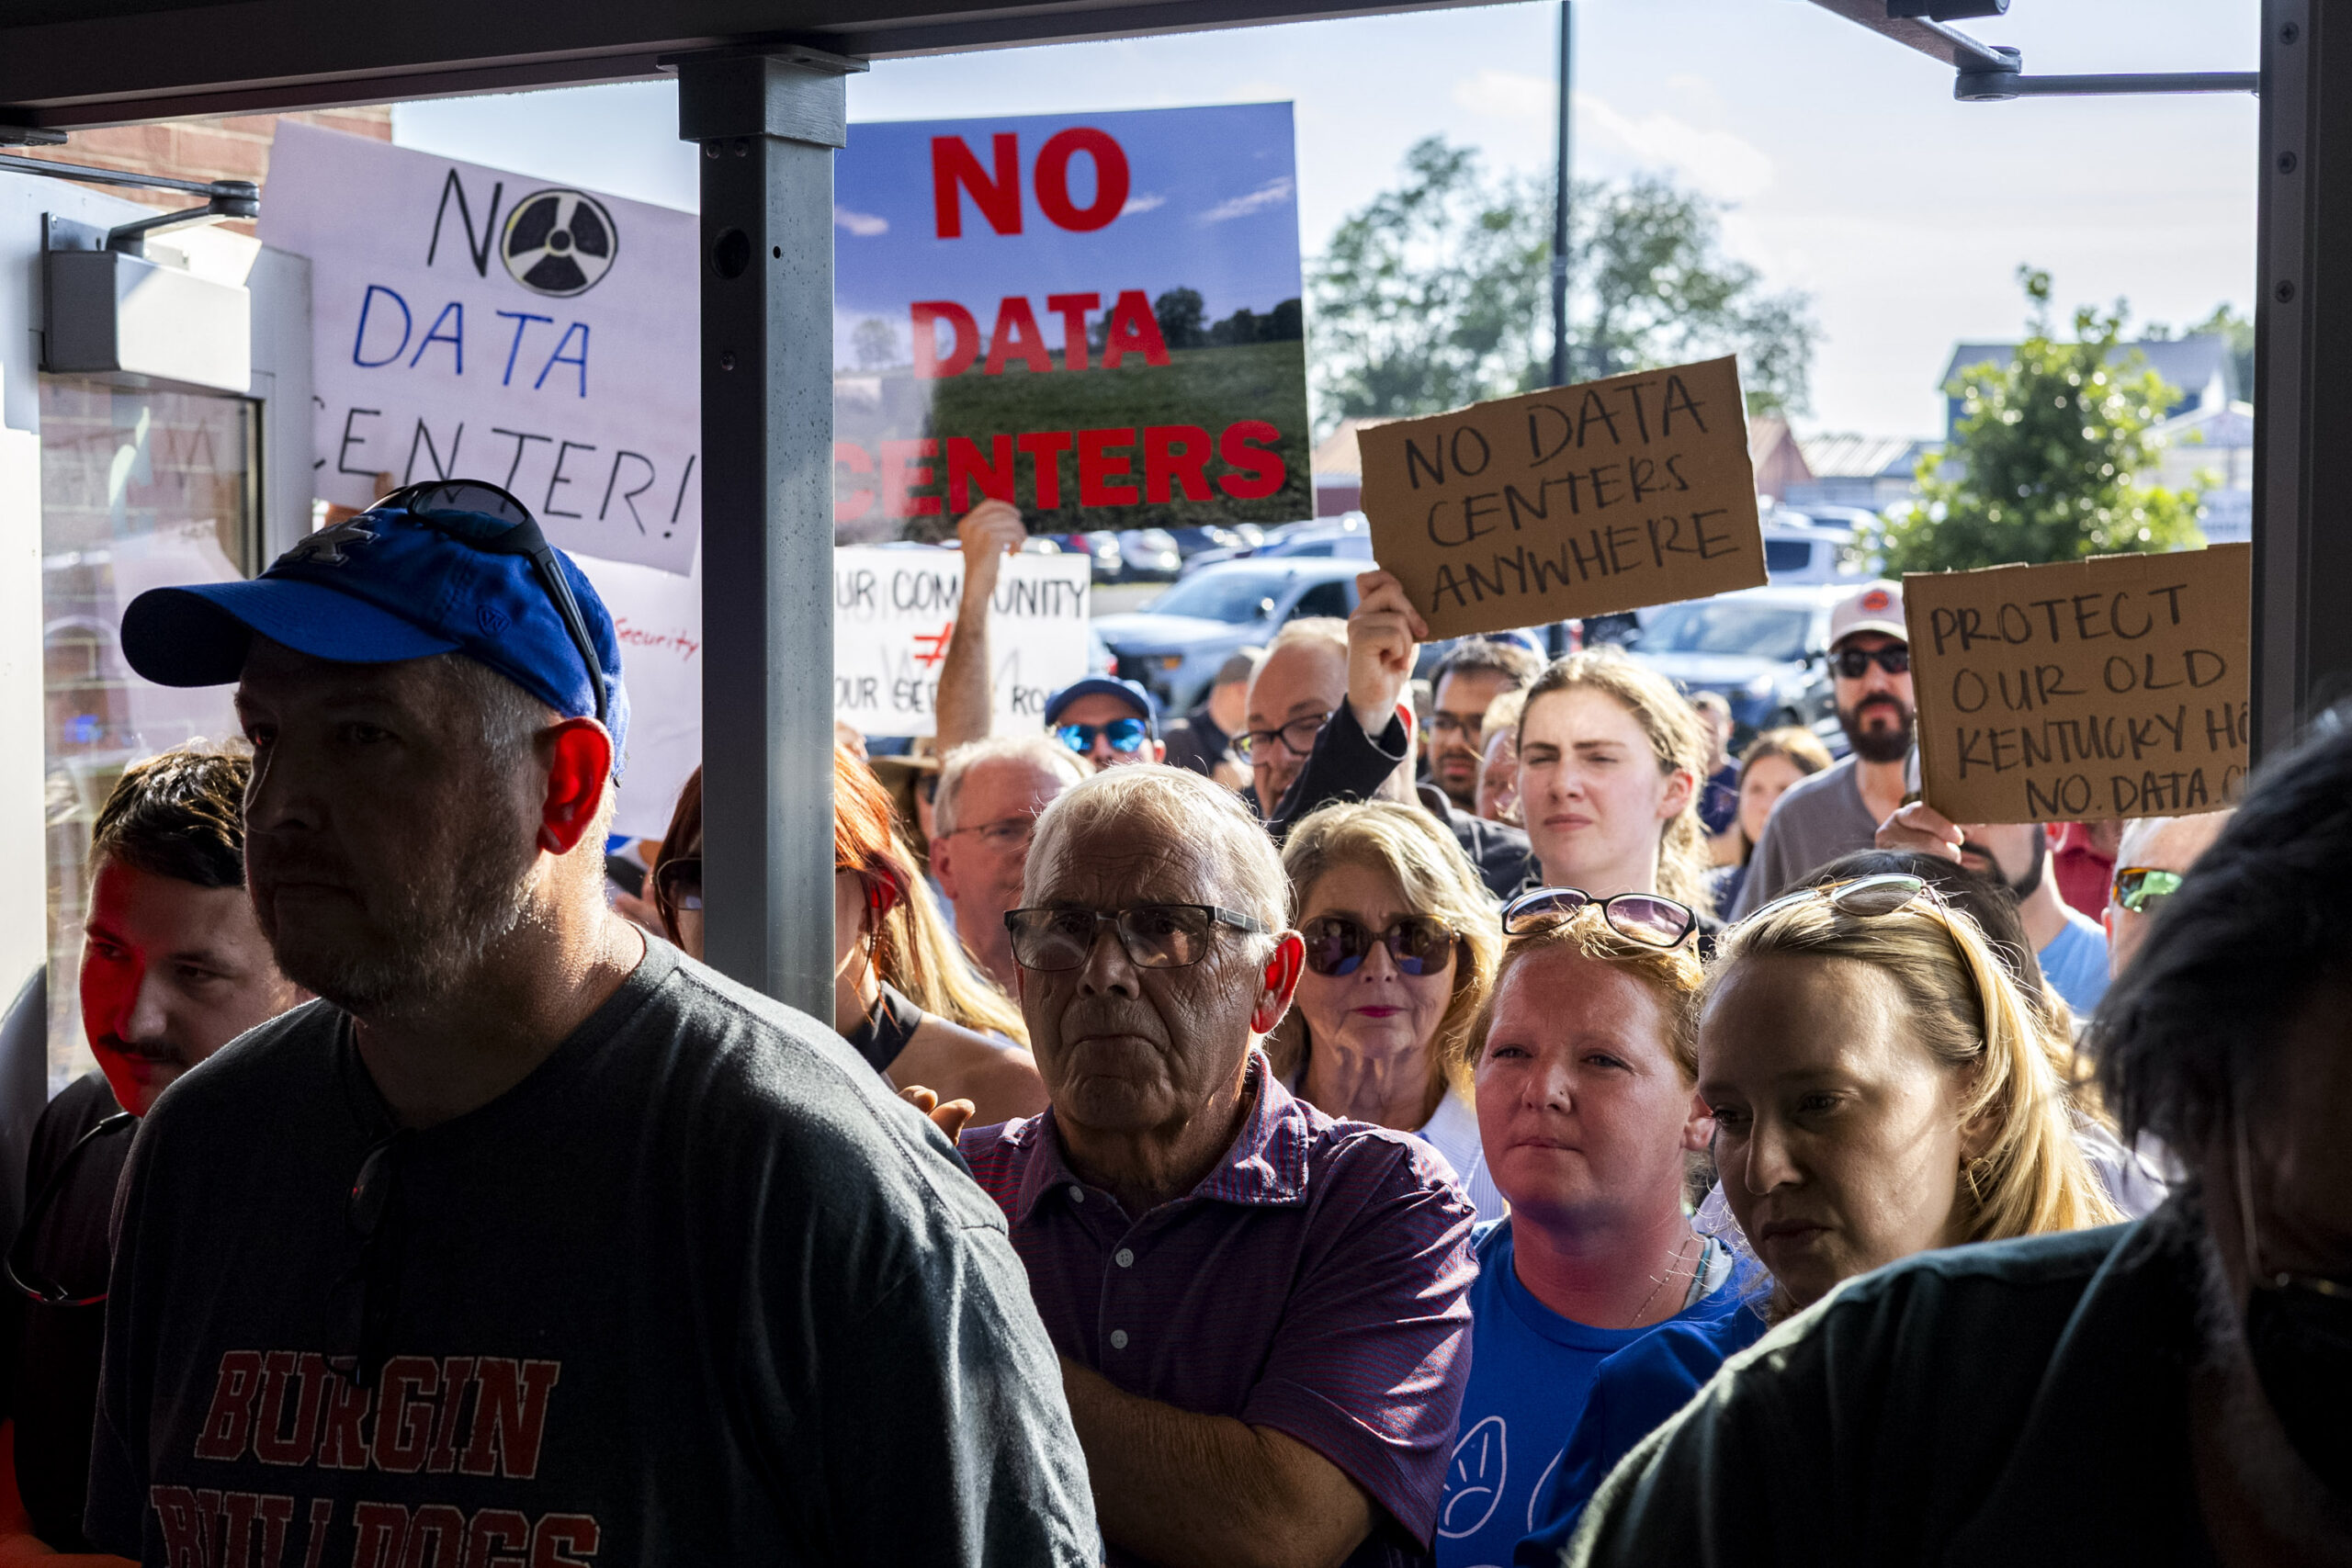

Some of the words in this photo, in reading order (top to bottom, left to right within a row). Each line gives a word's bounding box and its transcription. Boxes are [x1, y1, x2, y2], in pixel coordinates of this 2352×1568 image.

[930, 126, 1131, 240] NO
[353, 285, 590, 398] DATA
[910, 288, 1172, 379] DATA
[312, 395, 696, 538] ENTER!
[834, 419, 1287, 523] CENTERS
[1405, 426, 1490, 490] NO
[1527, 374, 1709, 468] DATA
[1427, 454, 1690, 547] CENTERS
[1431, 508, 1741, 613] ANYWHERE
[615, 617, 699, 661] Security
[1931, 584, 2188, 656] PROTECT
[1952, 663, 2087, 714] OUR
[2104, 649, 2226, 694] OLD
[1957, 705, 2186, 780] KENTUCKY
[194, 1349, 561, 1480] BURGIN
